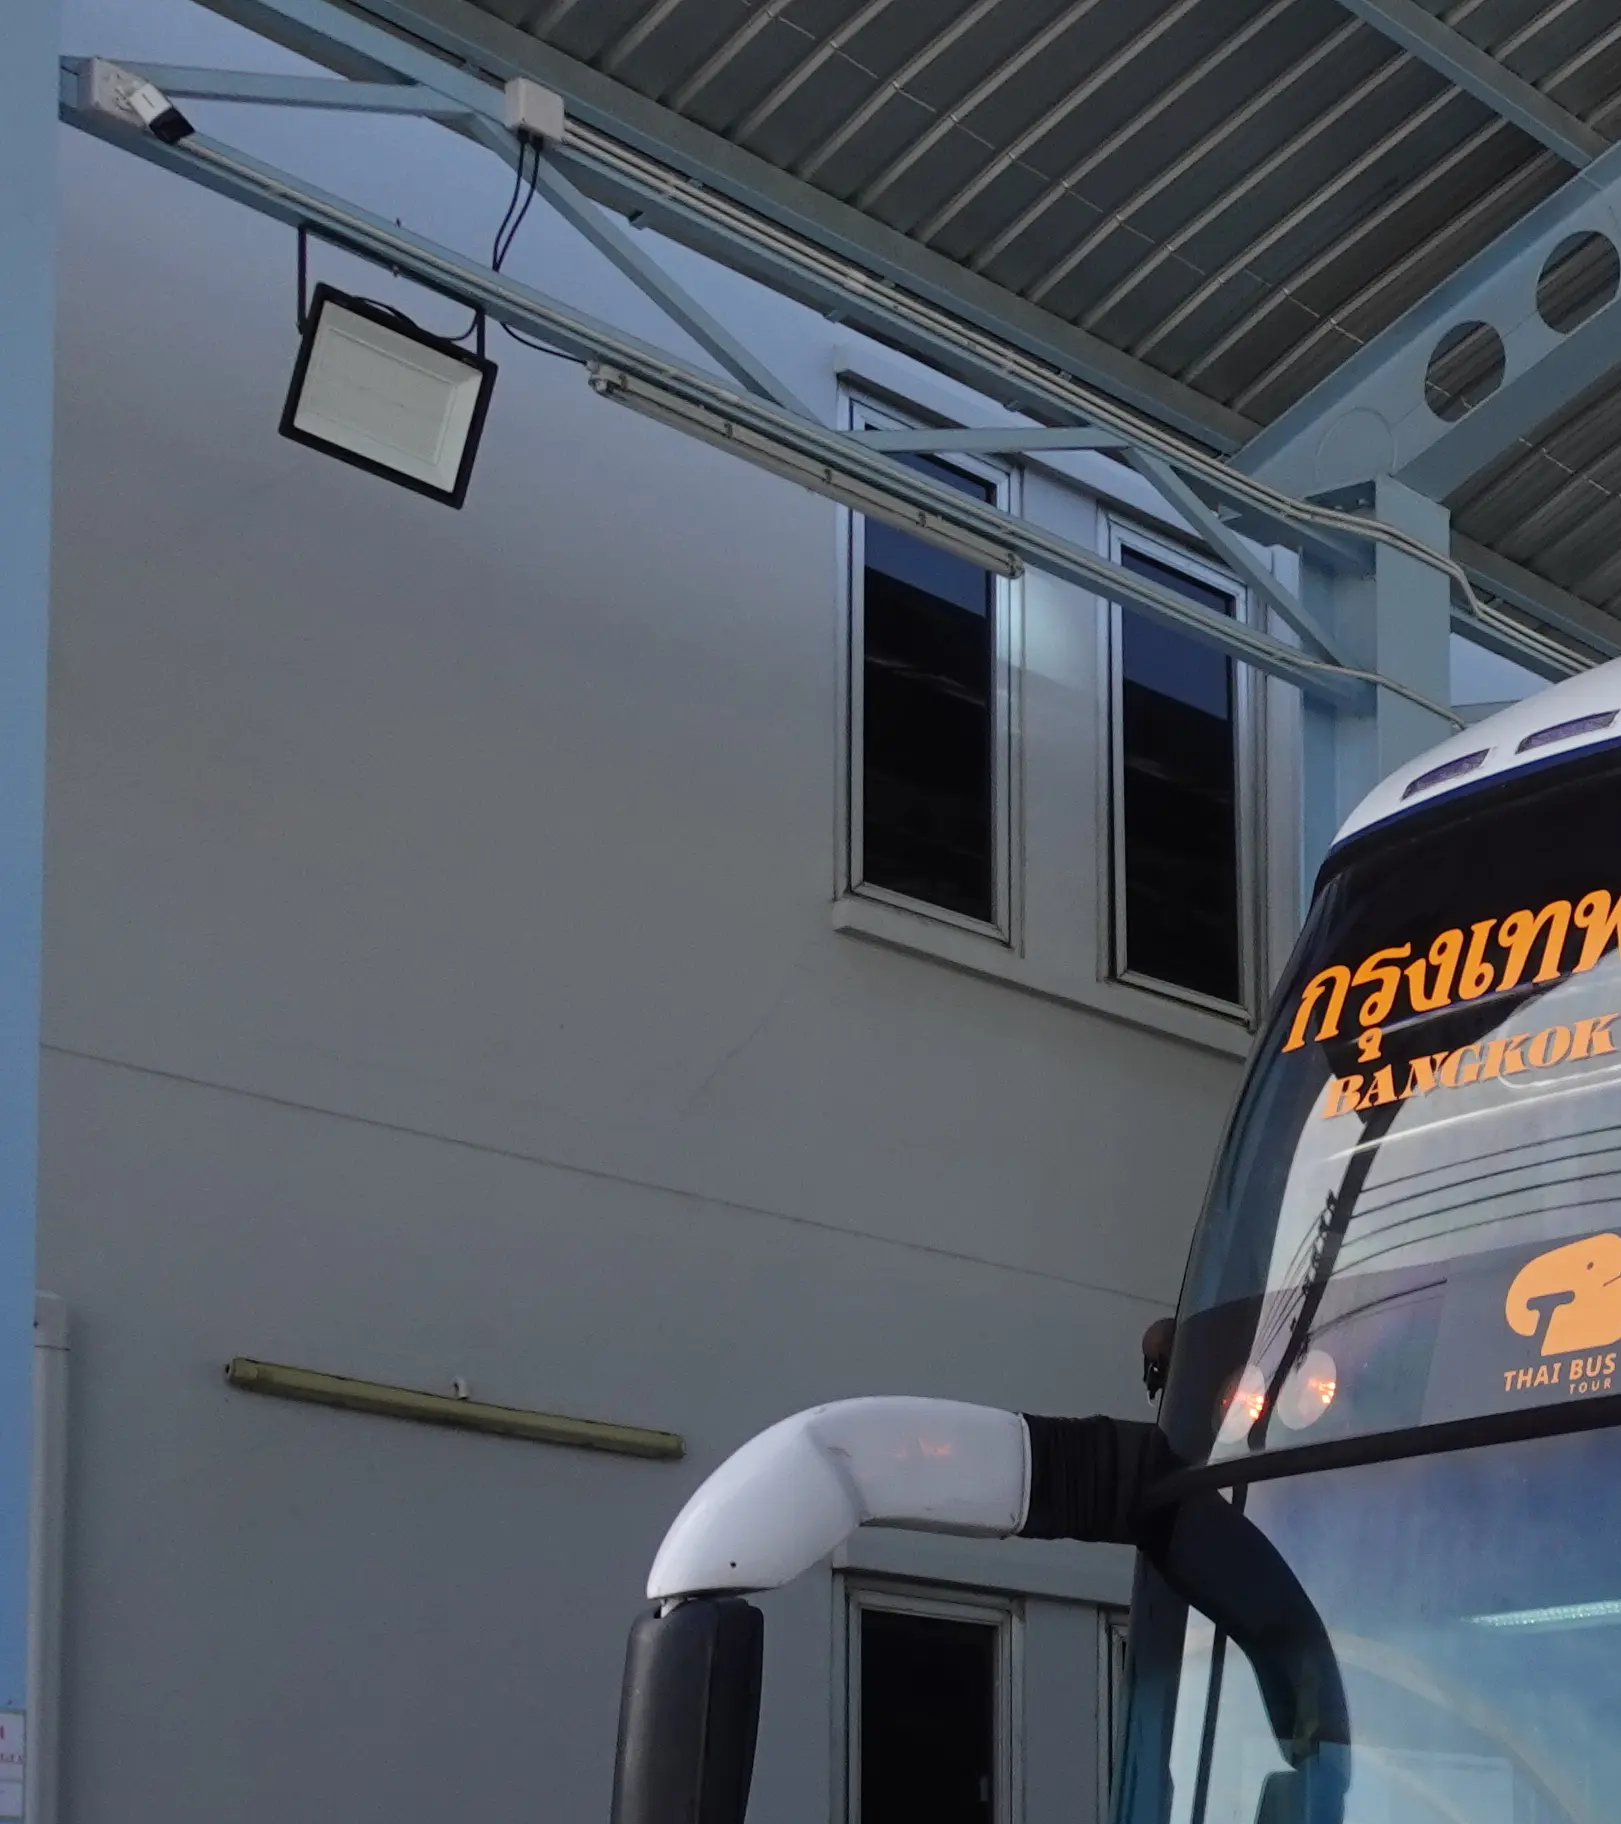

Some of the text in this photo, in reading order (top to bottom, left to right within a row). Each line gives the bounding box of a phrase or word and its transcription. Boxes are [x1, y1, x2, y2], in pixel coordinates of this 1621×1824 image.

[1321, 1012, 1621, 1119] BANGKOK
[1503, 1351, 1618, 1392] THAI BUS
[1568, 1377, 1613, 1396] TOUR
